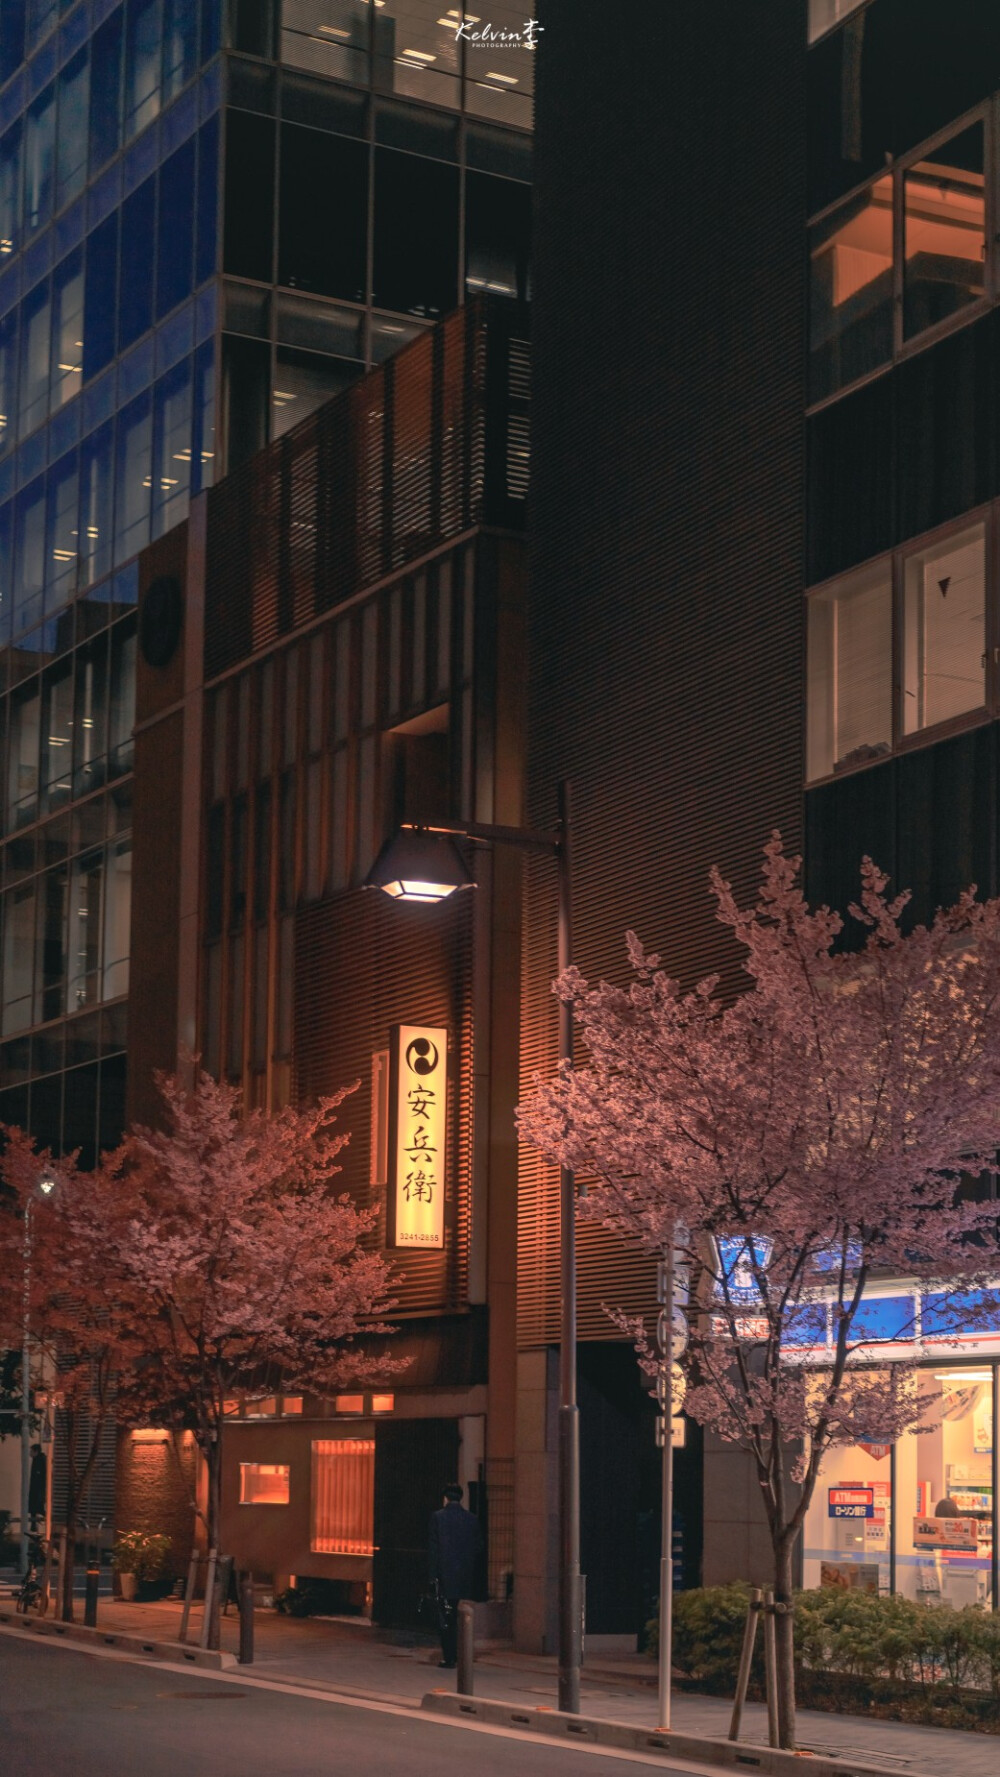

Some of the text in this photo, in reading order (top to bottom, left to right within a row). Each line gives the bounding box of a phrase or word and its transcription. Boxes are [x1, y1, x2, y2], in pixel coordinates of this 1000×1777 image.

[402, 1083, 438, 1204] 安兵衛
[870, 1445, 886, 1457] ATM
